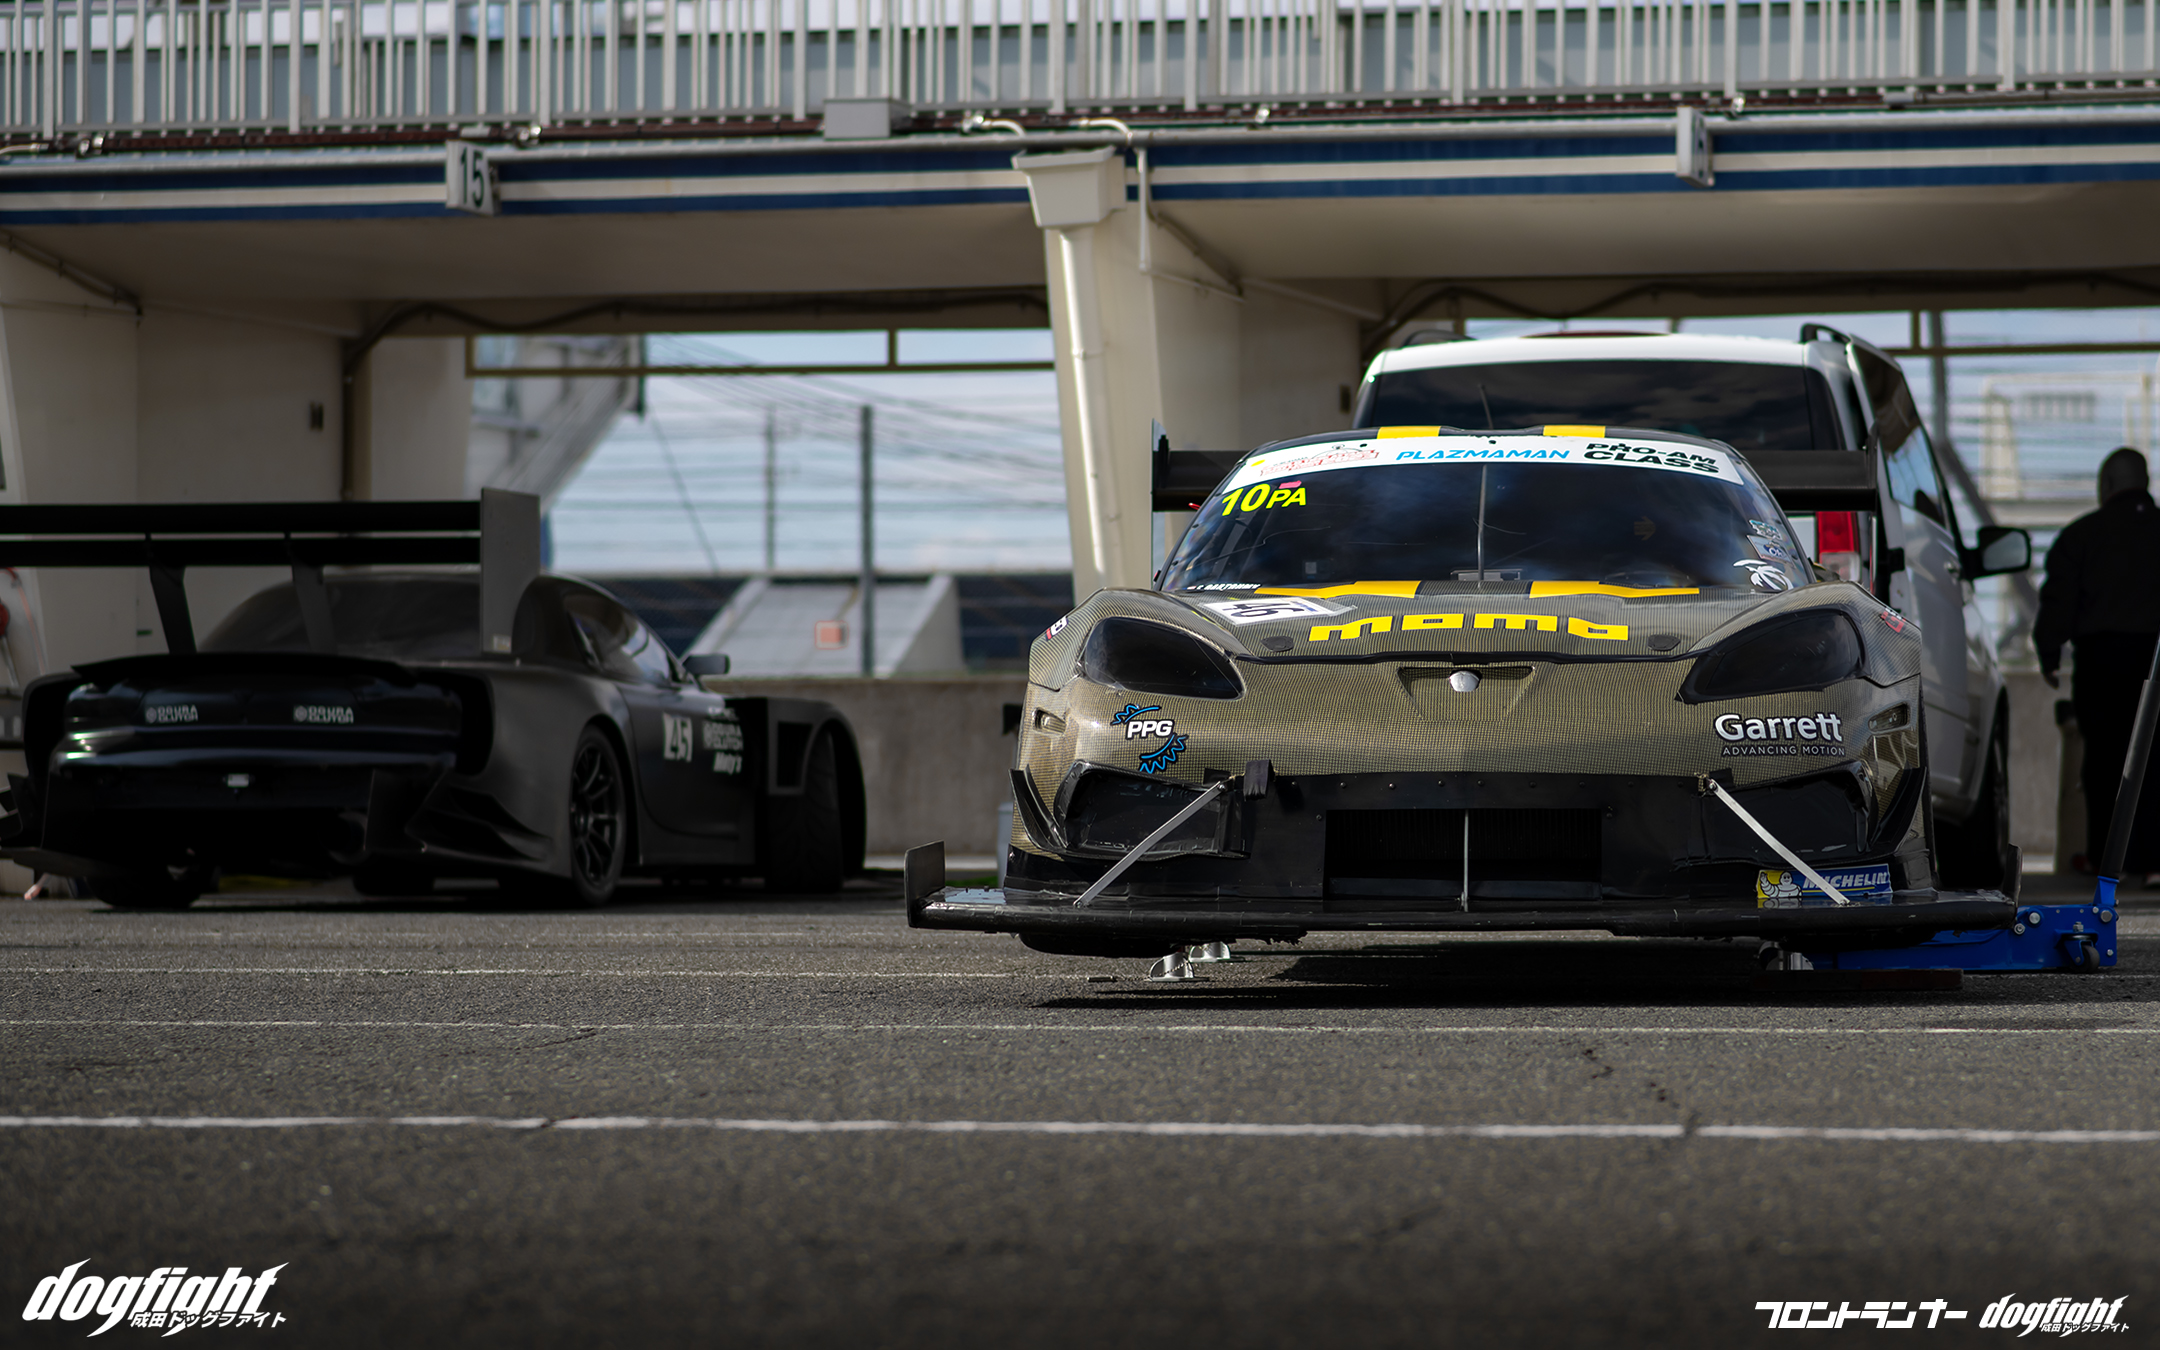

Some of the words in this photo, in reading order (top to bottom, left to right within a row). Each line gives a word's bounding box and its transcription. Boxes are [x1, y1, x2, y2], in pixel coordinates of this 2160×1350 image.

[461, 146, 484, 207] 15
[1395, 449, 1570, 461] PLAZMAMAN
[1583, 450, 1720, 474] CLASS
[1585, 442, 1717, 465] PRO-AM
[1126, 719, 1174, 739] PPG
[1714, 713, 1843, 742] Garrett
[1722, 746, 1797, 756] ADVANCING
[1802, 746, 1845, 756] MOTION
